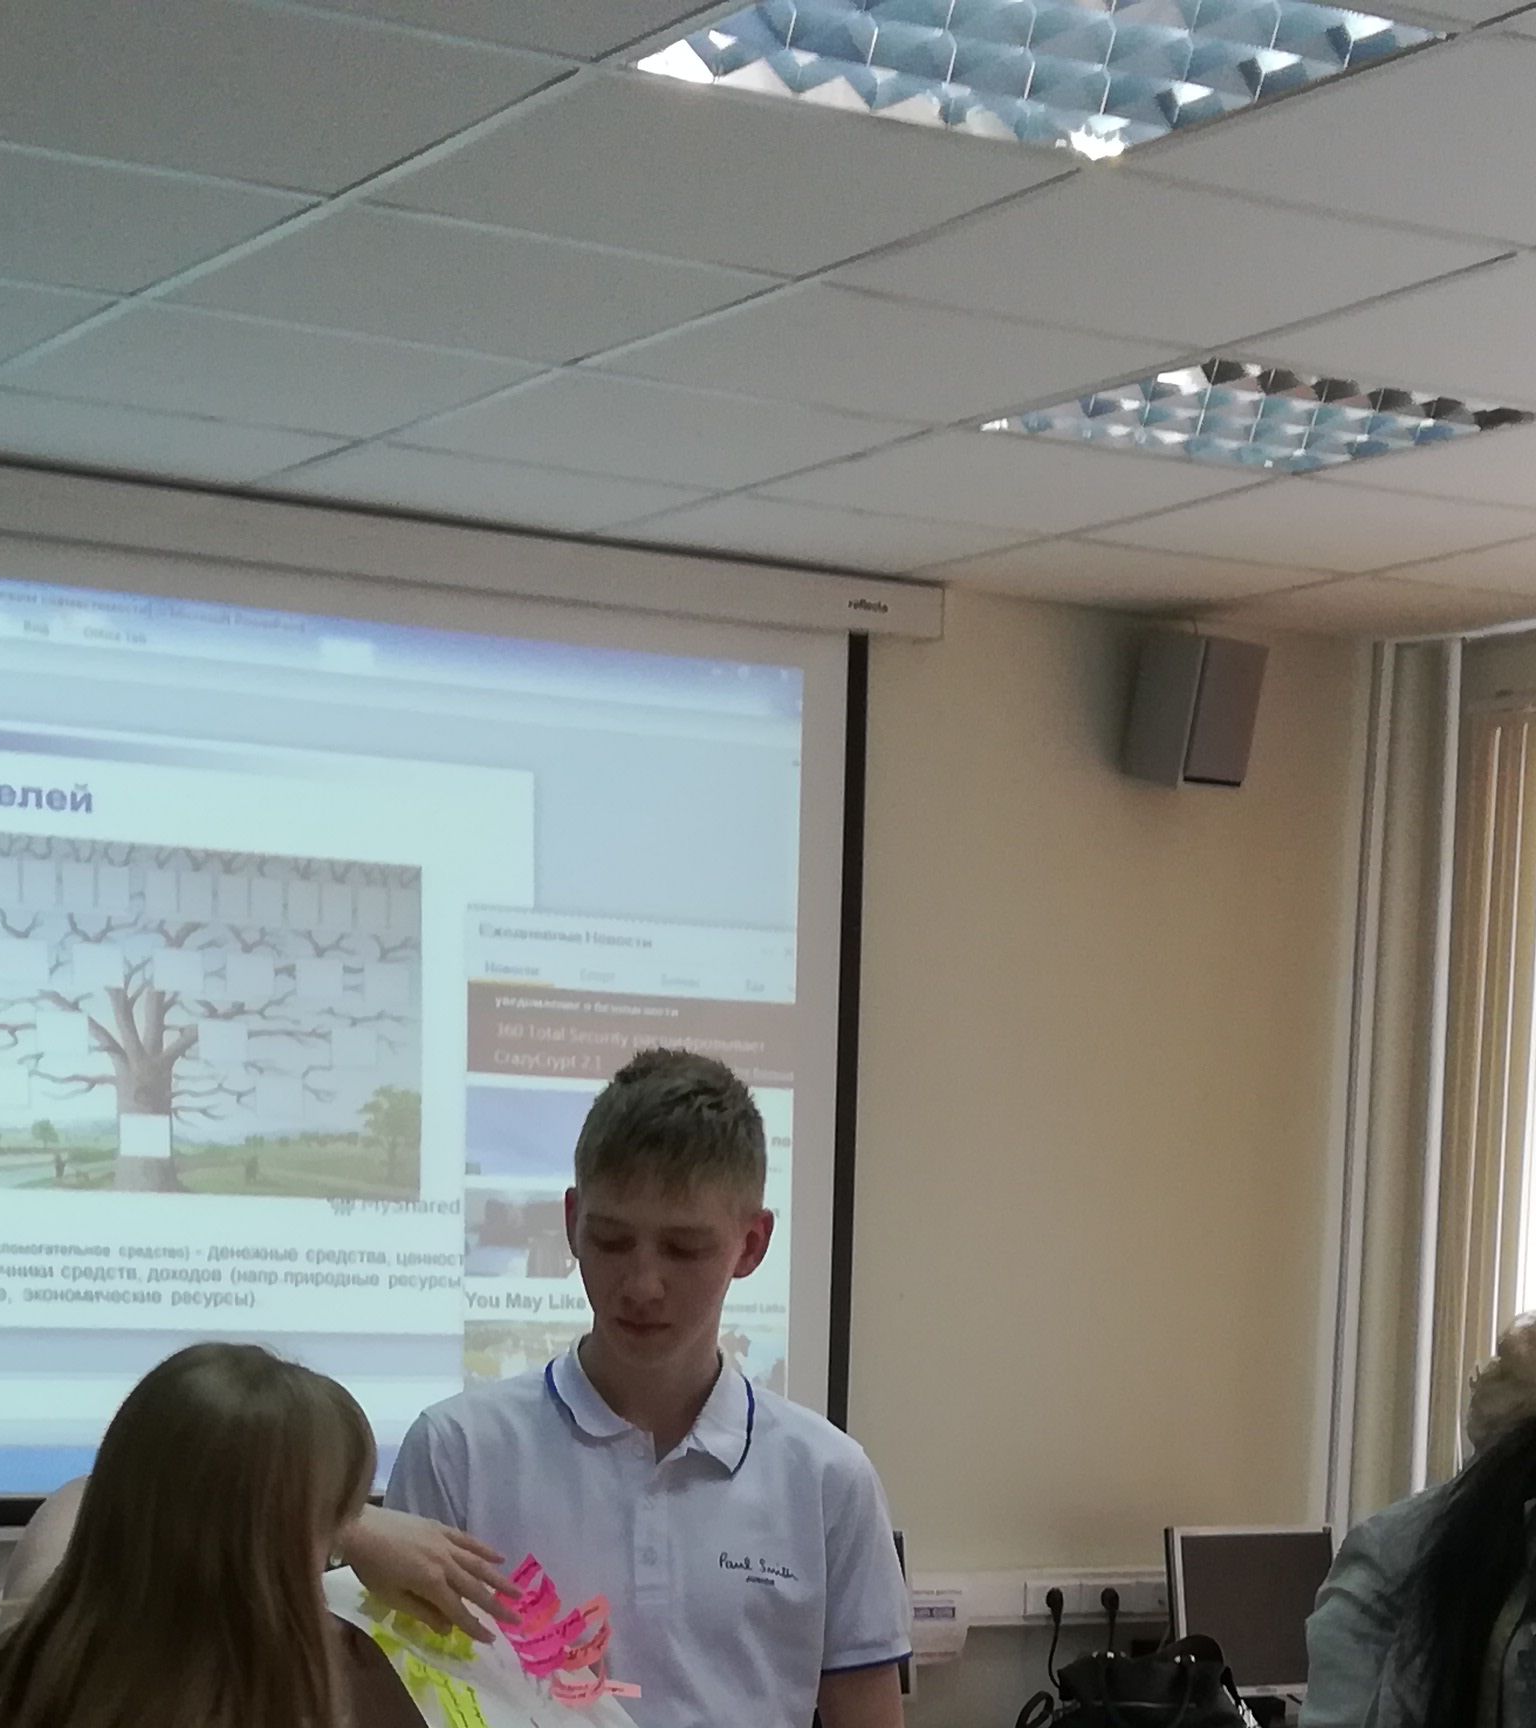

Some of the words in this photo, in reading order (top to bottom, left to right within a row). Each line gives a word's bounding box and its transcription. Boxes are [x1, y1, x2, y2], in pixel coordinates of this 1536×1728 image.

[207, 1244, 299, 1263] денежные
[147, 1266, 222, 1284] доходов
[22, 1287, 162, 1306] экономические
[466, 1292, 500, 1309] You
[505, 1292, 542, 1312] May
[549, 1293, 587, 1311] Like
[719, 1551, 752, 1571] Paul
